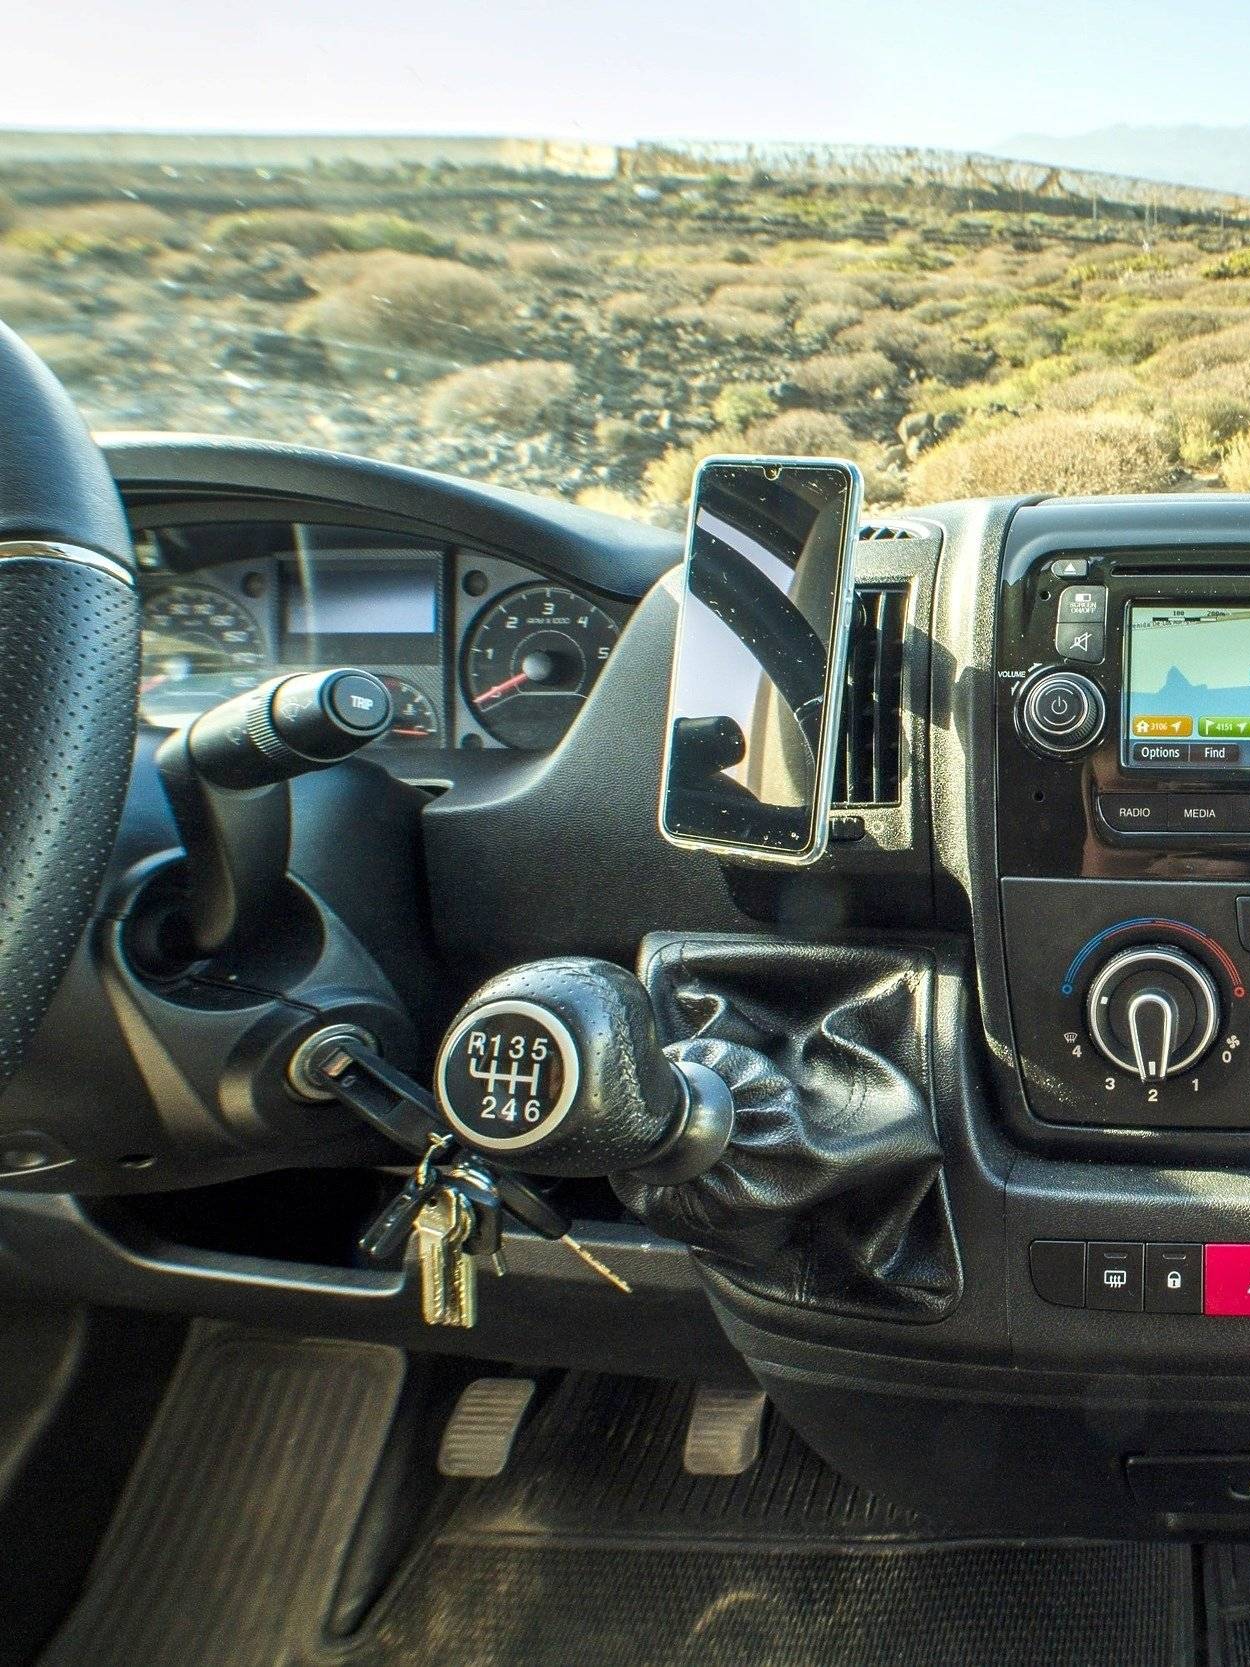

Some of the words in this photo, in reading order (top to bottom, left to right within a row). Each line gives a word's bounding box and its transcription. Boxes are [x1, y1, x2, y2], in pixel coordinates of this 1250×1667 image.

[541, 602, 555, 615] 3
[504, 616, 519, 629] 2
[576, 616, 589, 629] 4
[486, 648, 494, 660] 1
[597, 647, 611, 659] 5
[349, 694, 374, 711] TRIP
[1141, 746, 1180, 760] Options
[1204, 746, 1226, 758] Find
[1119, 807, 1151, 818] RADIO
[1183, 808, 1216, 818] MEDIA
[467, 1031, 487, 1056] R
[491, 1034, 501, 1057] 1
[508, 1035, 526, 1059] 3
[531, 1037, 548, 1061] 5
[1071, 1045, 1082, 1058] 4
[1221, 1050, 1232, 1063] 0
[1104, 1077, 1116, 1090] 3
[1191, 1078, 1199, 1091] 1
[1147, 1089, 1158, 1102] 2
[480, 1095, 497, 1119] 2
[501, 1098, 518, 1122] 4
[524, 1099, 541, 1122] 6
